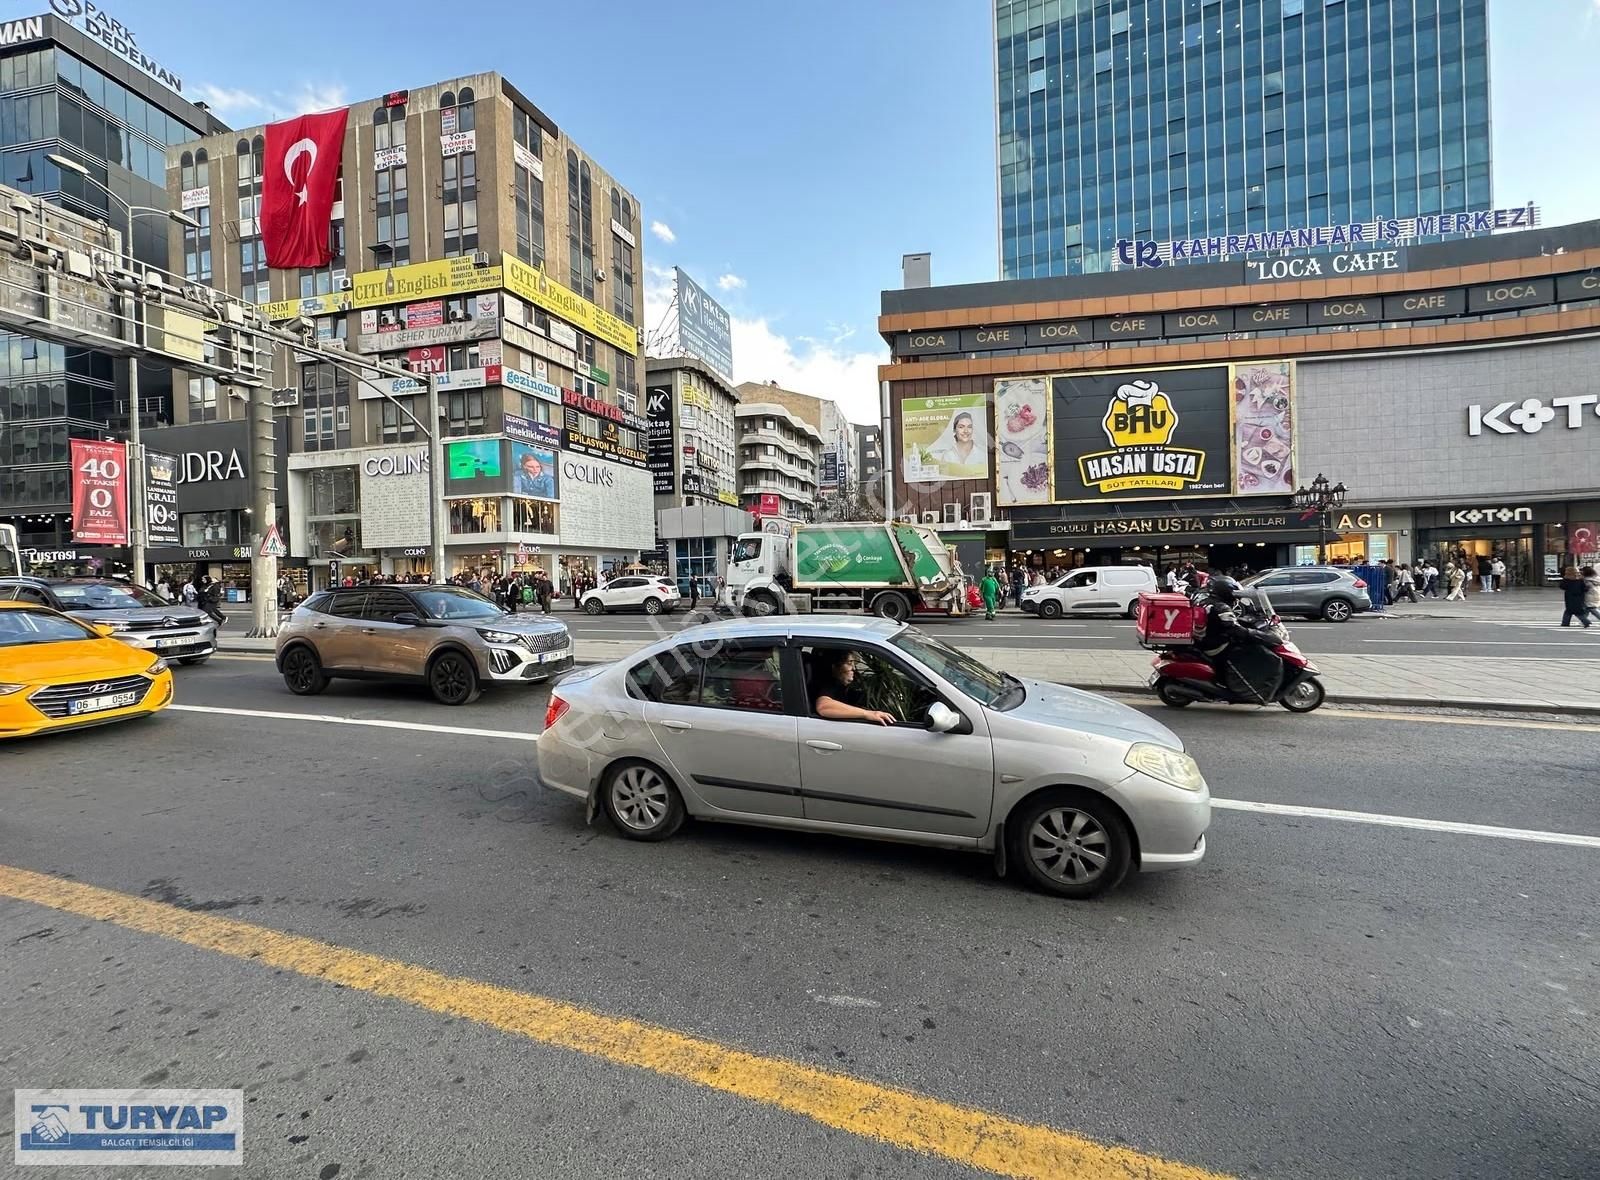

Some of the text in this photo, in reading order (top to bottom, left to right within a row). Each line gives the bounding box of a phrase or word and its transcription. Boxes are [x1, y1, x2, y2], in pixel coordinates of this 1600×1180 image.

[84, 0, 137, 46] PARK
[86, 19, 182, 92] DEDEMAN
[1172, 224, 1364, 258] KAHRAMANLAR
[1377, 215, 1401, 243] İŞ
[1416, 200, 1535, 236] MERKEZİ
[1258, 258, 1322, 280] LOCA
[1332, 250, 1399, 273] CAFE
[355, 283, 384, 300] CITI
[396, 273, 448, 295] English
[511, 263, 587, 318] CITI English
[910, 335, 945, 349] LOCA
[976, 329, 1010, 343] CAFE
[1040, 324, 1078, 338] LOCA
[1110, 319, 1146, 333] CAFE
[1179, 313, 1219, 328] LOCA
[1252, 307, 1290, 322] CAFE
[1323, 302, 1367, 317] LOCA
[1403, 295, 1446, 310] CAFE
[1486, 285, 1537, 302] LOCA
[395, 330, 425, 344] SEHER
[410, 358, 443, 374] THY
[506, 370, 558, 398] gezinomi
[505, 425, 560, 446] sineklikler.com
[569, 432, 610, 451] EPİLASYON
[610, 444, 617, 453] &
[80, 458, 121, 479] 40
[564, 460, 614, 487] COLIN'S
[1087, 453, 1196, 480] HASAN USTA
[1129, 479, 1177, 487] TATLILARI
[90, 488, 112, 508] 0
[147, 492, 176, 504] KRALI
[89, 509, 113, 517] FAİZ
[1050, 515, 1287, 535] BOLULU HASAN USTA SÜT TATLILARI
[188, 550, 210, 558] PUDRA
[404, 548, 426, 556] COLIN'S
[76, 692, 134, 710] 06 T 0554
